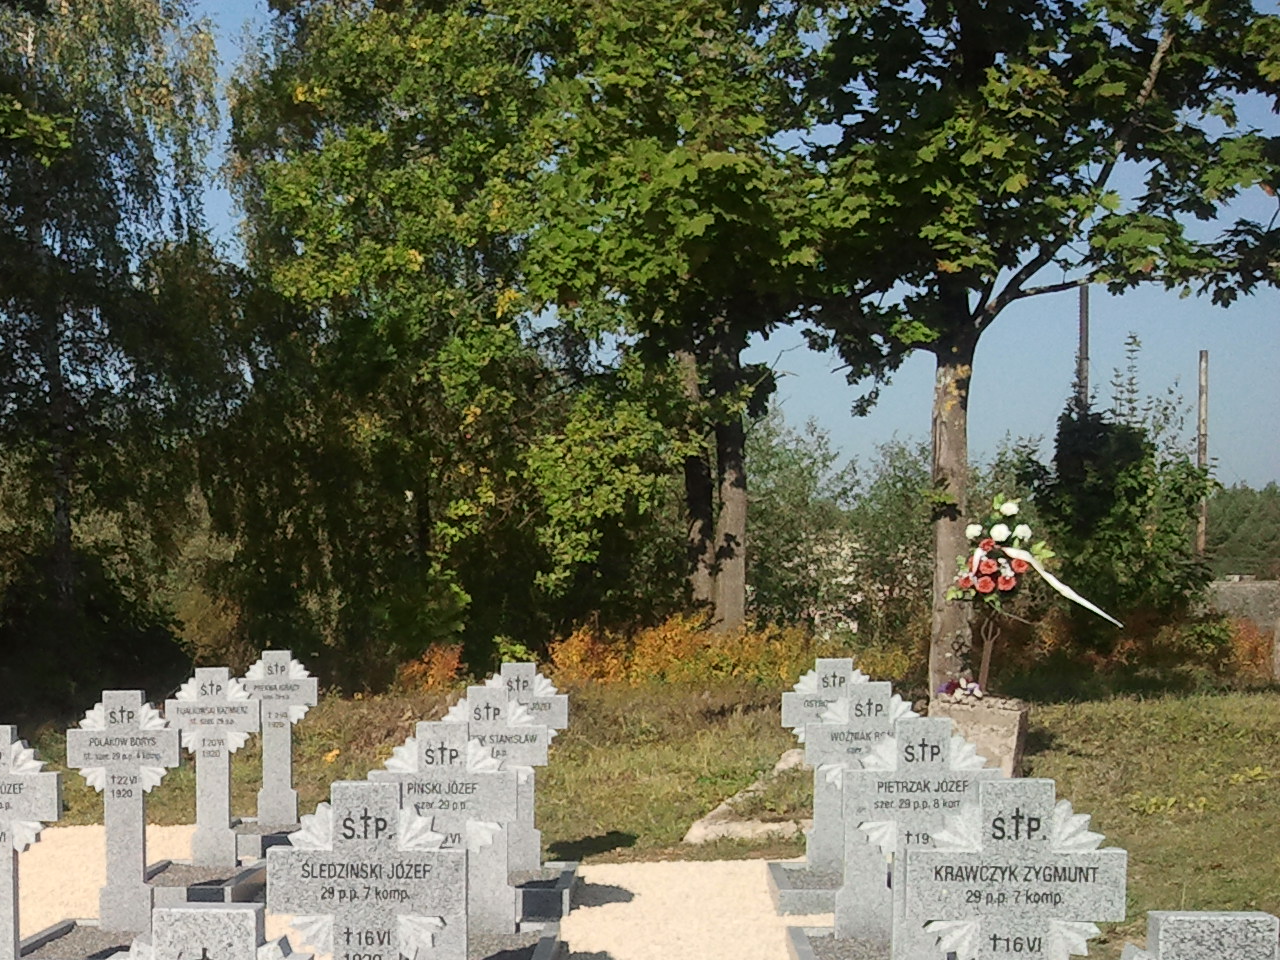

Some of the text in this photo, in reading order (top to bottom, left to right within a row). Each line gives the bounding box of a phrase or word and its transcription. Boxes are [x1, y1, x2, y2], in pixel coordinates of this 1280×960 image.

[111, 788, 133, 798] 1920
[445, 780, 478, 794] JÓZEF
[877, 778, 969, 793] PIETRZAK JÓZEF
[898, 799, 911, 808] 29
[933, 799, 939, 808] 8
[387, 862, 432, 879] JÓZEF
[934, 866, 1099, 883] KRAWCZYK ZYGMUNT
[320, 886, 410, 902] 29 p.p. 7 komp.
[966, 890, 1065, 905] 29 p.p. 7 komp.
[376, 931, 391, 946] VI
[1026, 937, 1042, 952] VI
